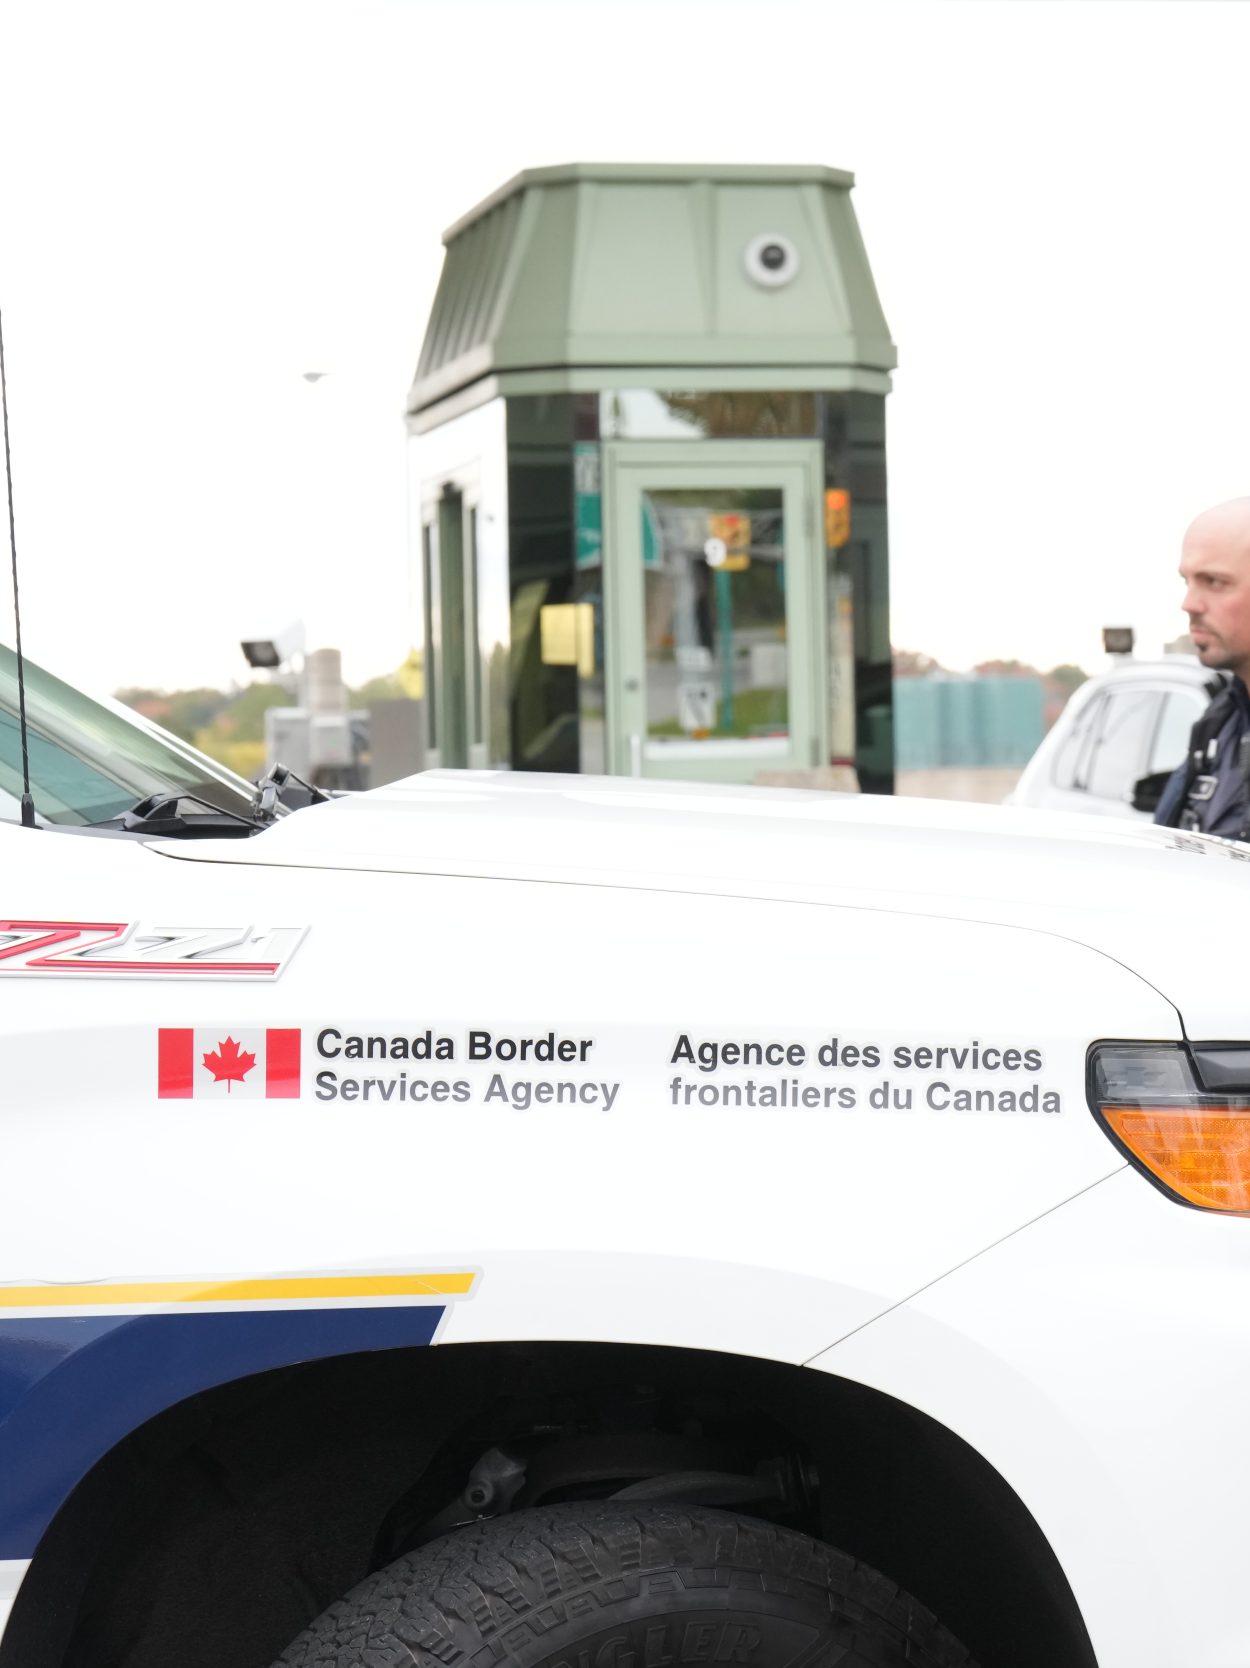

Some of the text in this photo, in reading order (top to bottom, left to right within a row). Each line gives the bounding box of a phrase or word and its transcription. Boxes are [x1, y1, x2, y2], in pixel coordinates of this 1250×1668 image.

[316, 1027, 593, 1063] Canada Border
[670, 1034, 1043, 1073] Agence des services
[315, 1070, 620, 1112] Services Agency
[669, 1076, 1061, 1114] frontaliers du Canada
